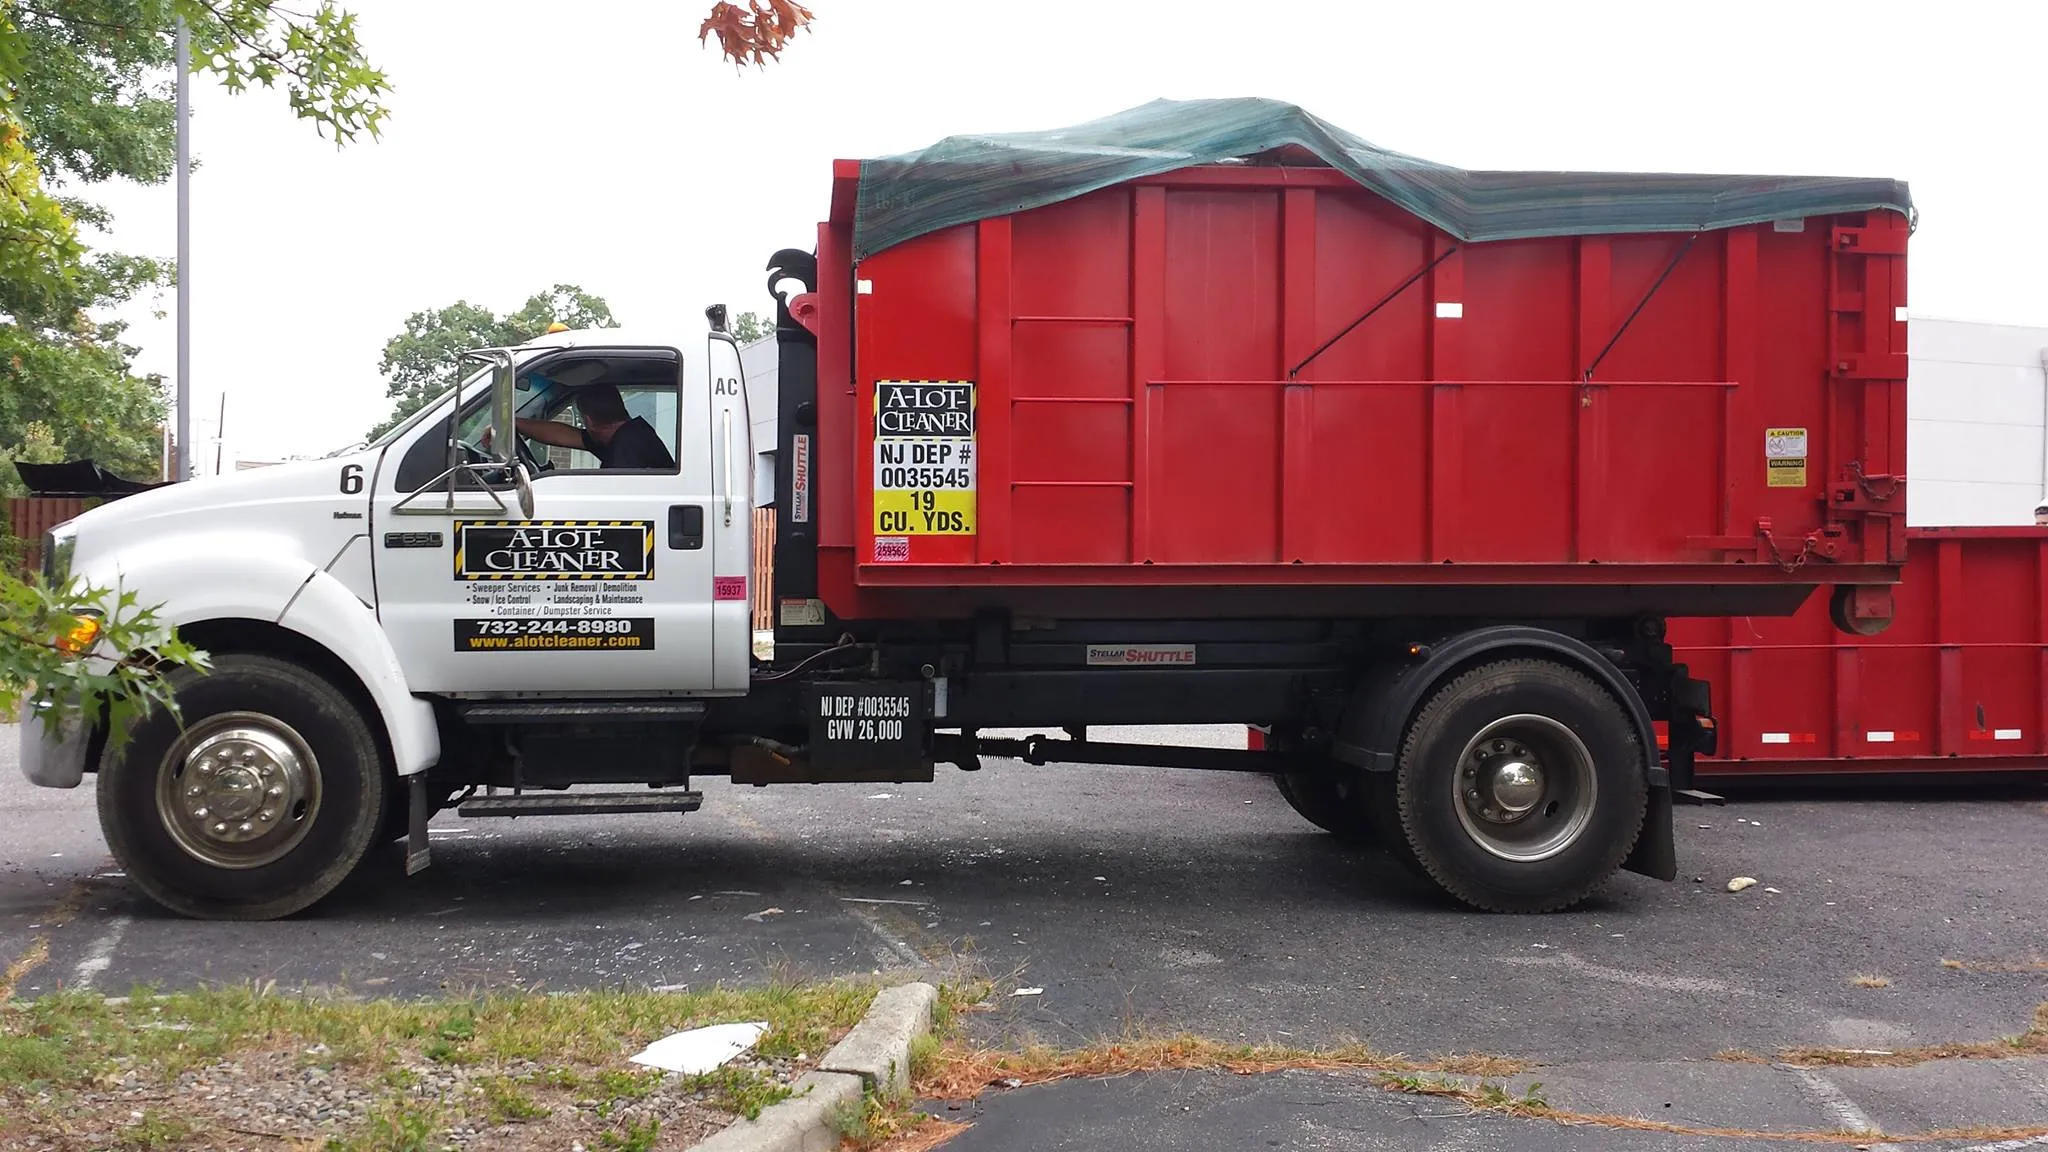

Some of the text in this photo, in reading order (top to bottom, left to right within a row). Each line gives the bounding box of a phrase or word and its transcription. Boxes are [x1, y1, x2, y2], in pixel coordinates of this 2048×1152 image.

[714, 378, 738, 396] AC
[881, 411, 970, 432] CLEANER
[795, 436, 806, 491] SHUTTLE
[880, 444, 971, 465] NJ DEP #
[340, 464, 363, 494] 6
[881, 467, 970, 488] 0035545
[910, 491, 935, 511] 19
[880, 511, 970, 532] CU. YDS.
[485, 549, 623, 571] CLEANER
[472, 583, 541, 593] Sweeper Services
[554, 583, 568, 592] Junk
[570, 583, 597, 592] Removal
[603, 583, 637, 592] Demolition
[716, 585, 741, 595] 15937
[472, 595, 490, 604] Snow
[496, 595, 506, 604] Ice
[507, 595, 531, 604] Control
[554, 595, 595, 605] Landscaping
[602, 595, 643, 604] Maintenance
[497, 606, 535, 615] Container
[543, 606, 580, 617] Dumpster
[583, 606, 612, 615] Service
[477, 620, 632, 634] 732-244-8980
[469, 635, 641, 648] www.alotcleaner.com
[1125, 649, 1194, 662] SHUTTLE
[821, 696, 910, 717] NJ DEP #0035545
[828, 719, 902, 743] GVW 26,000
